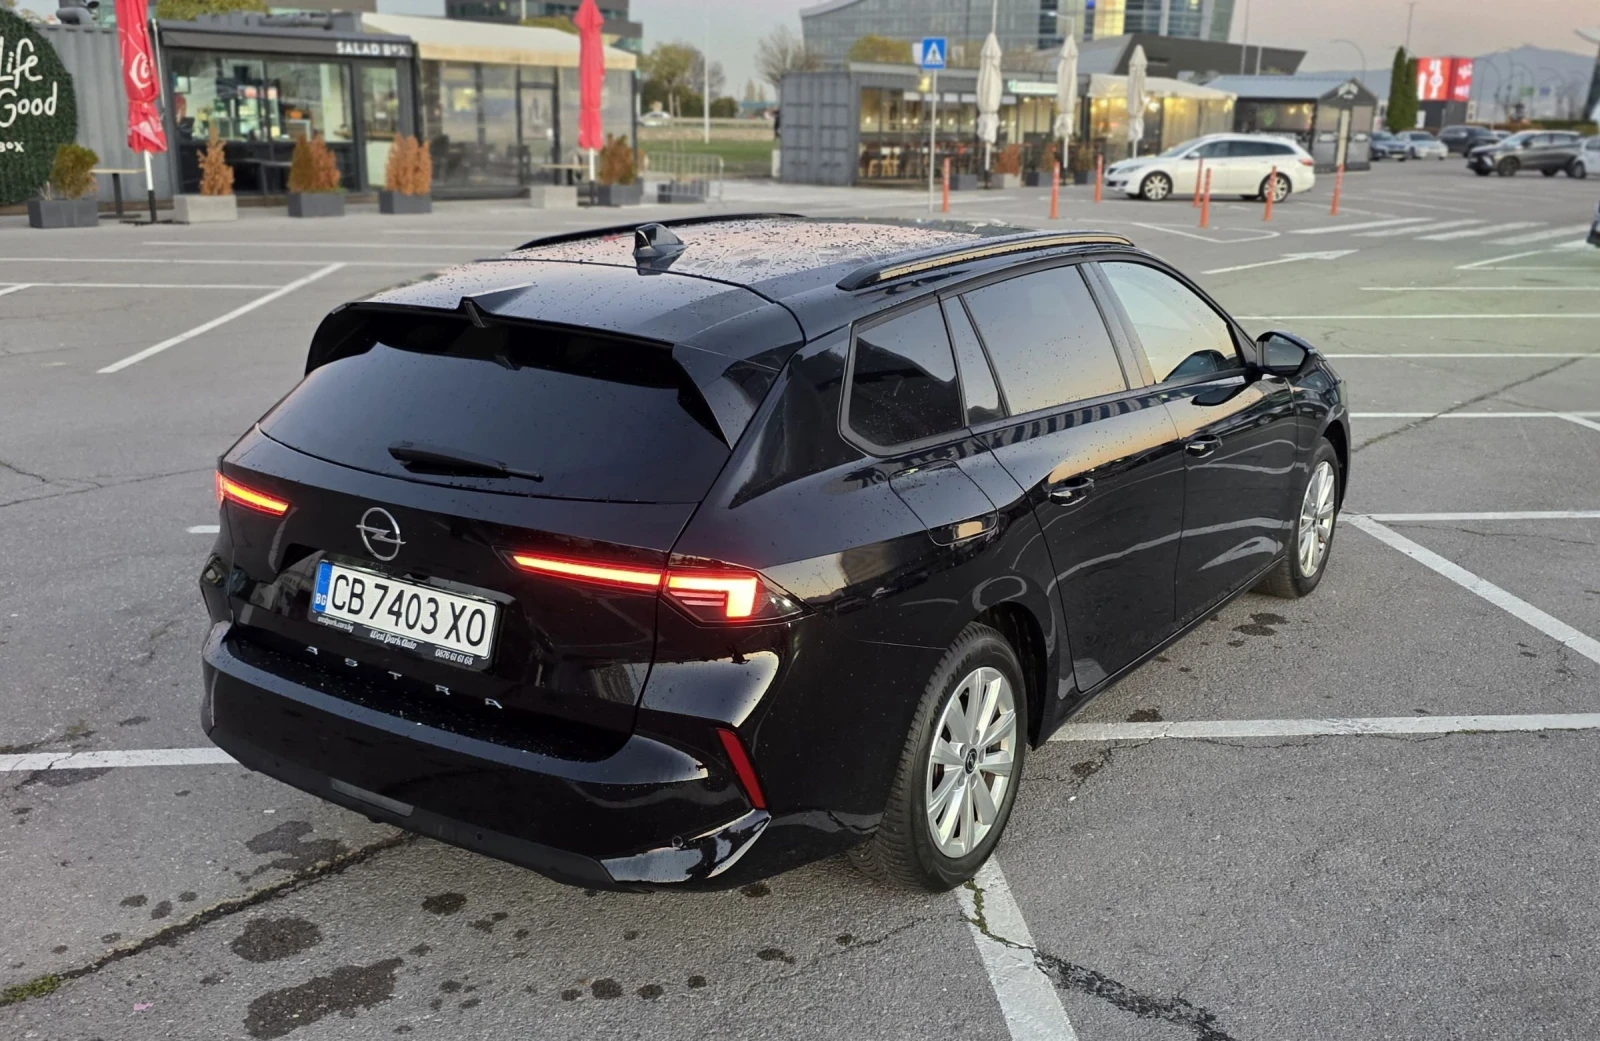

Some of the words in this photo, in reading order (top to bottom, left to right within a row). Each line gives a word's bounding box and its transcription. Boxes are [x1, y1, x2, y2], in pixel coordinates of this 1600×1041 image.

[0, 36, 43, 90] Life
[336, 41, 380, 55] SALAD
[0, 81, 58, 128] Good
[315, 592, 327, 605] BG
[331, 574, 366, 615] CB
[368, 583, 440, 635] 7403
[444, 601, 486, 647] XO
[370, 629, 386, 641] West
[383, 633, 401, 646] Park
[305, 645, 503, 709] ASTRA
